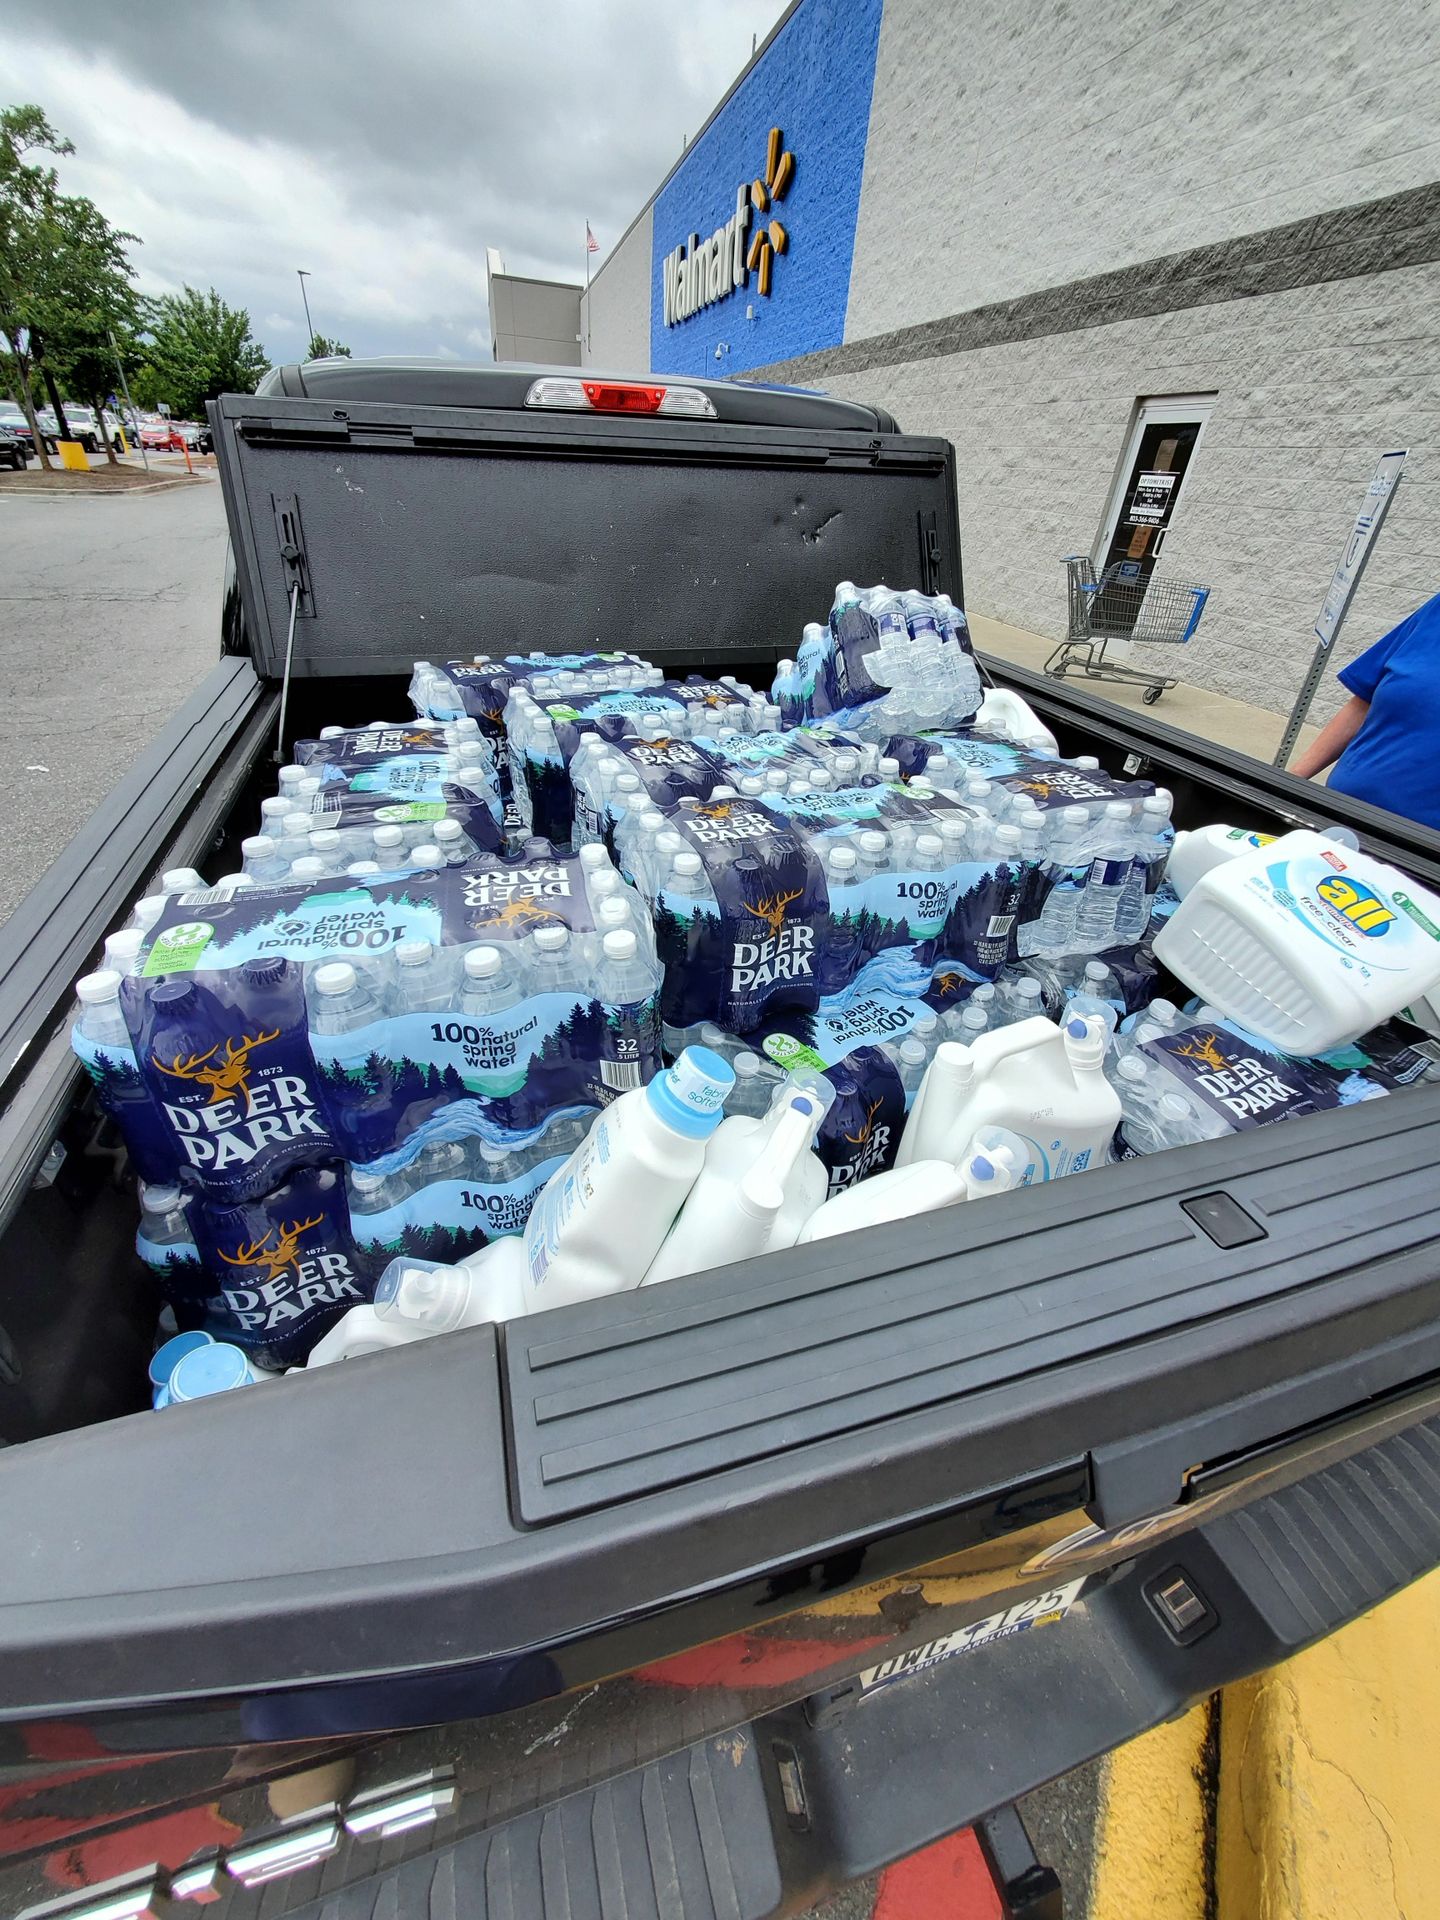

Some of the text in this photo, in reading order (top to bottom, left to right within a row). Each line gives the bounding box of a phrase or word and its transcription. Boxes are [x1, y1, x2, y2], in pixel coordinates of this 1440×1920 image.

[663, 183, 749, 328] Walmart
[798, 650, 820, 665] atural
[352, 730, 380, 755] PARK
[382, 730, 405, 753] DEER
[486, 736, 507, 752] DE
[683, 812, 772, 831] DEER
[693, 821, 784, 843] PARK
[460, 866, 570, 890] PARK
[896, 881, 946, 900] 100%
[461, 881, 573, 907] DEER
[1316, 879, 1398, 932] all
[316, 910, 385, 924] water
[917, 907, 946, 919] wate
[1300, 896, 1324, 917] free
[1327, 921, 1357, 948] clear
[257, 925, 408, 951] 100% natural
[313, 919, 385, 938] spring
[732, 925, 815, 967] DEER
[730, 951, 814, 993] PARK
[842, 999, 880, 1020] water
[849, 1006, 889, 1028] spring
[430, 1016, 538, 1045] 100% natural
[833, 1005, 915, 1045] 100% natural
[462, 1040, 516, 1058] spring
[616, 1038, 638, 1052] 32
[624, 1053, 640, 1061] LITER
[464, 1053, 517, 1070] water
[178, 1066, 284, 1104] EST. 1873
[1193, 1057, 1274, 1098] DEER
[161, 1076, 316, 1134] DEER
[1220, 1075, 1300, 1120] PARK
[177, 1108, 328, 1171] PARK
[460, 1180, 549, 1214] 100% natura
[487, 1200, 534, 1223] spring
[488, 1214, 530, 1230] wate
[305, 1246, 327, 1257] 1873
[223, 1253, 354, 1312] DEER
[232, 1277, 364, 1331] PARK
[998, 1584, 1070, 1628] 125
[907, 1624, 1020, 1675] SOUTH CAROLINA
